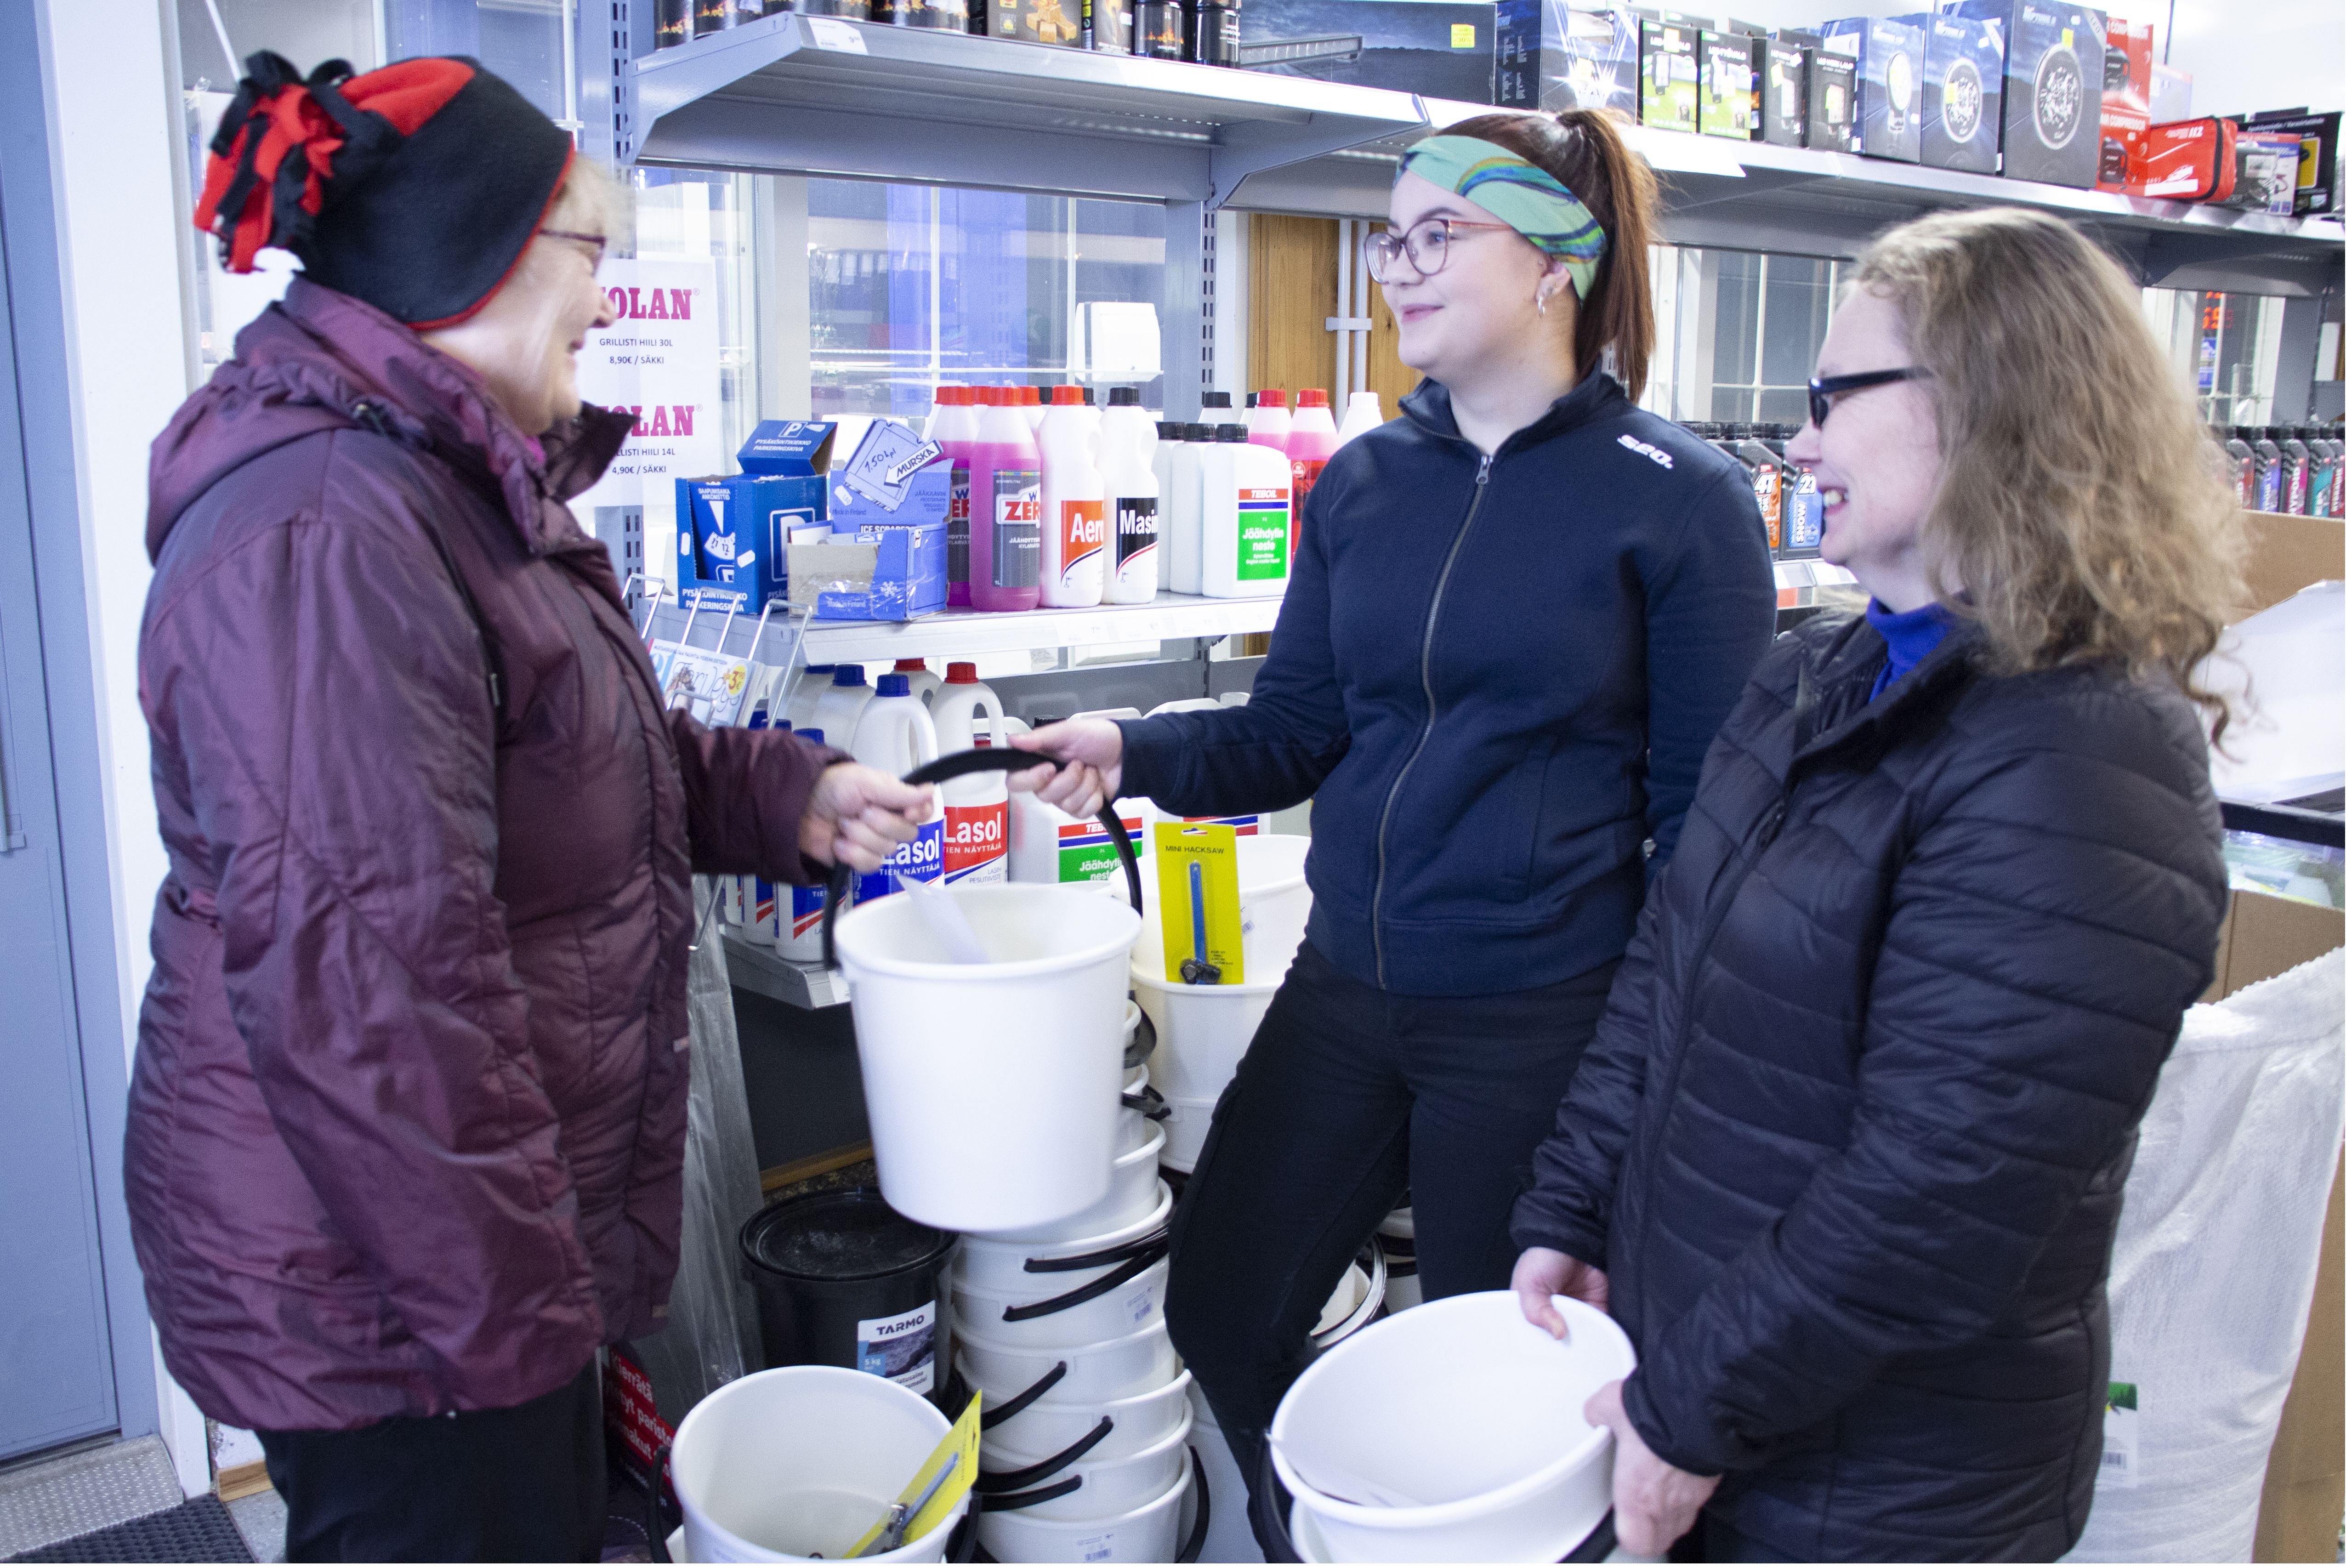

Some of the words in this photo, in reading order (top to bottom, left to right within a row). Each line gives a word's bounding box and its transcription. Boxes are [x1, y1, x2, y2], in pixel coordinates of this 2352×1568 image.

[601, 287, 692, 320] OLAN
[609, 356, 632, 365] 8,90€
[641, 354, 665, 364] SÄKKI
[597, 405, 695, 437] LAN
[897, 449, 935, 477] MURSKA
[612, 466, 634, 475] 4,90€
[643, 464, 666, 474] SÄKKI
[1754, 473, 1777, 494] 4T
[1250, 489, 1277, 499] TEBOIL
[1796, 501, 1807, 544] SNOW
[861, 525, 873, 533] ICE
[1242, 528, 1284, 541] Jäähdytin
[722, 543, 729, 553] 12
[1252, 540, 1276, 551] neste
[686, 600, 744, 612] PAKERINGSKVA
[943, 811, 1001, 843] Lasol
[1085, 822, 1107, 833] TEB
[964, 841, 1002, 853] NÄYTTÄJÄ
[1184, 846, 1224, 854] HACKSAW
[903, 861, 940, 875] NÄYTTÄJÄ
[1090, 870, 1110, 881] nest
[876, 1314, 925, 1335] TARMO
